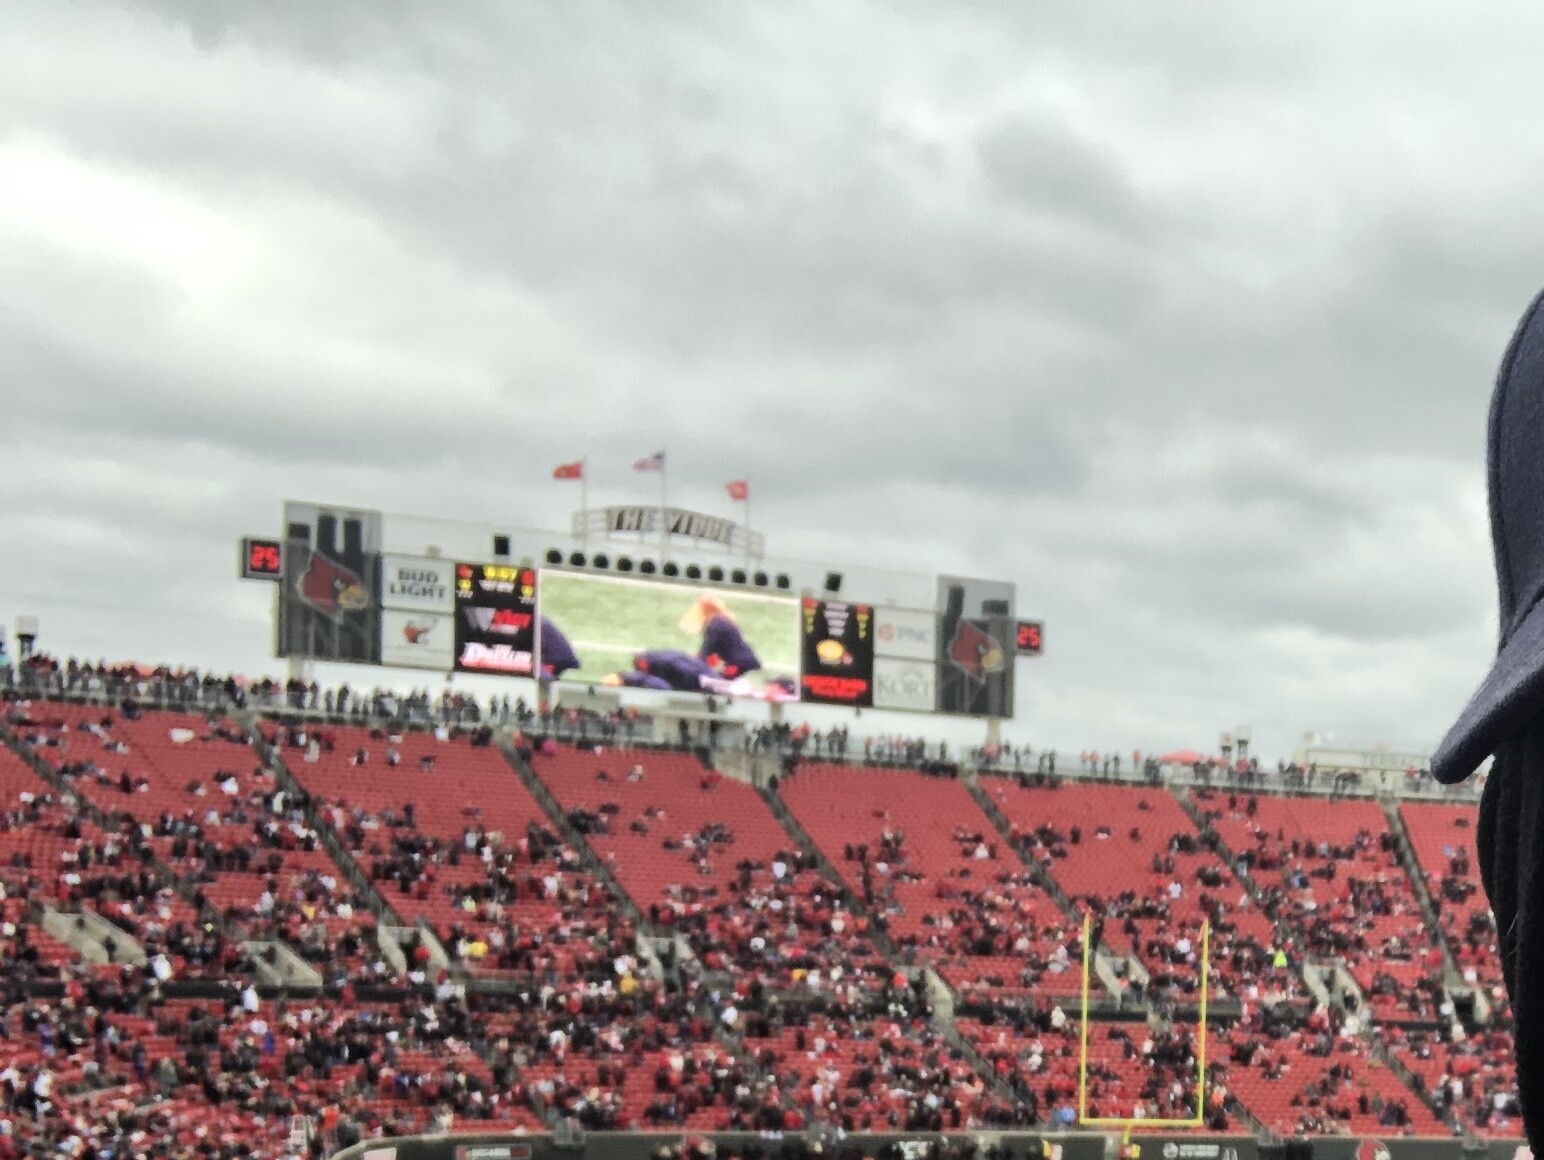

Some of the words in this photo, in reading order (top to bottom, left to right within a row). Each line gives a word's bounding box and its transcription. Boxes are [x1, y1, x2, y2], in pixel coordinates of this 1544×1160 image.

[251, 545, 279, 570] 25
[398, 569, 439, 584] BUD
[389, 583, 446, 599] LIGHT
[1016, 627, 1041, 648] 25
